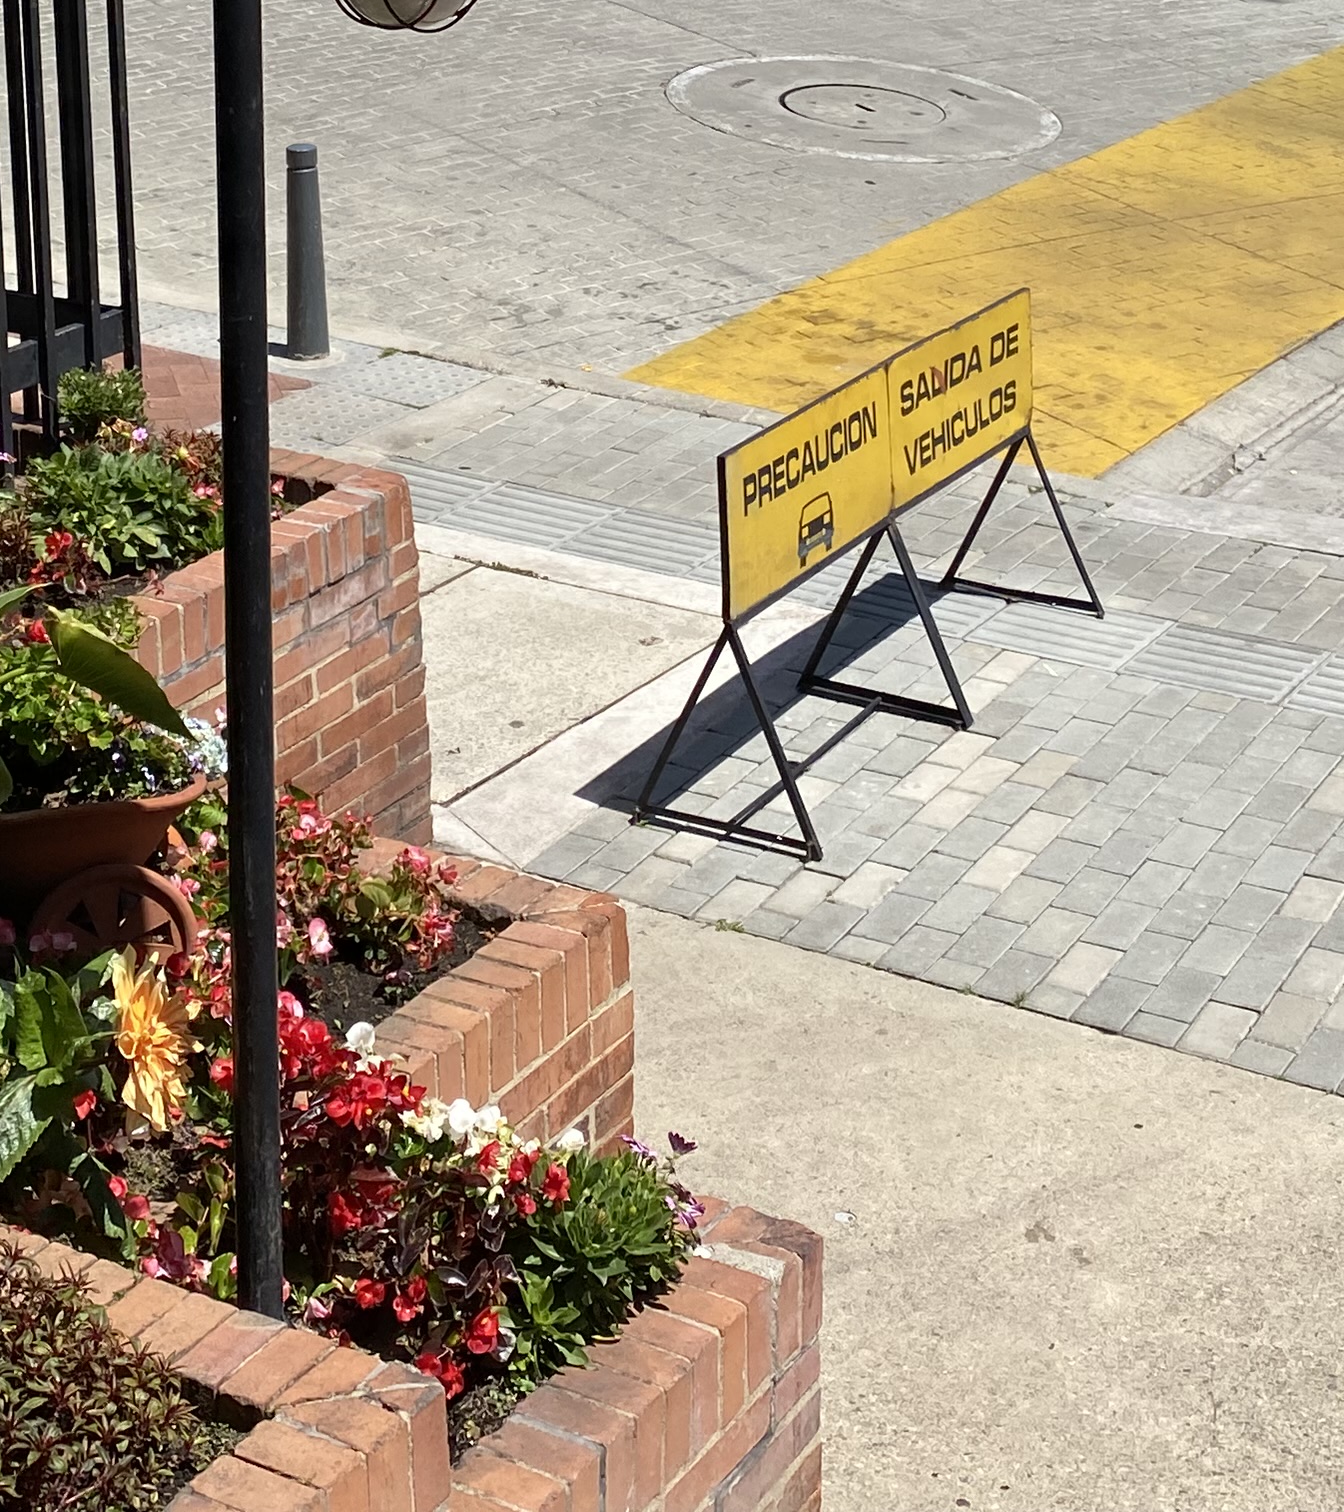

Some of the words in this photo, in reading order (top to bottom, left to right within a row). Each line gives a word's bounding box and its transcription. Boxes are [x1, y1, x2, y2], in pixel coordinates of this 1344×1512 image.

[899, 344, 982, 418] SALIDA
[989, 323, 1020, 368] DE
[742, 402, 878, 517] PRECAUCION
[903, 380, 1017, 476] VEHICULOS
